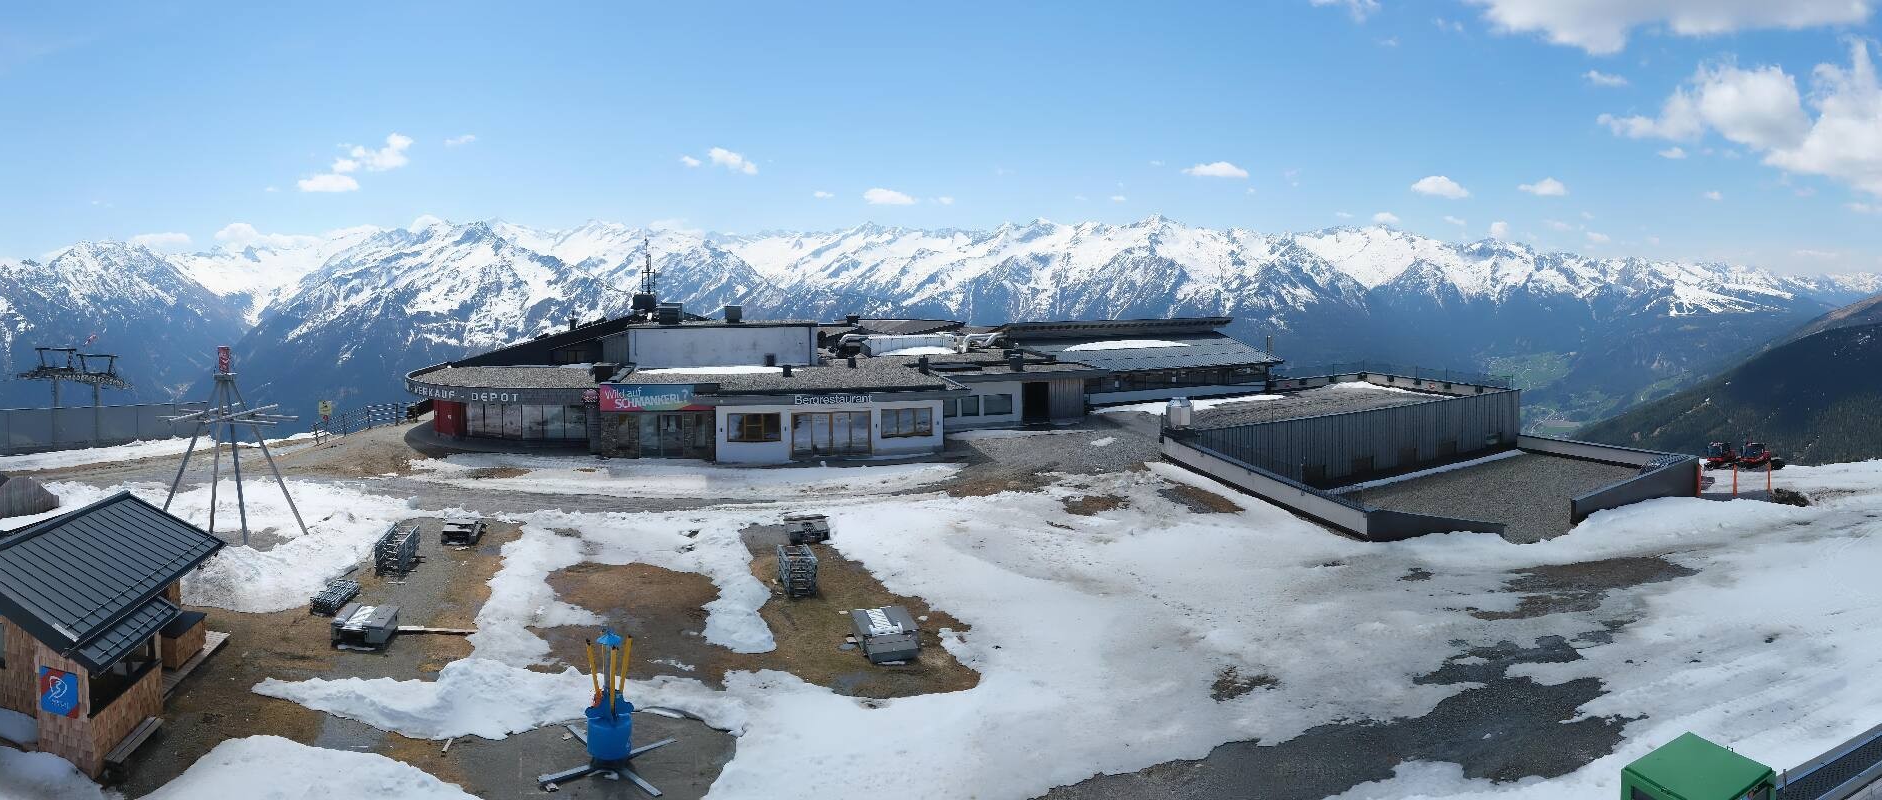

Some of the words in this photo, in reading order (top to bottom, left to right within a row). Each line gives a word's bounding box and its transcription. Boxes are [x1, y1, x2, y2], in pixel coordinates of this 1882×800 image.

[414, 385, 455, 399] VERKAUF
[472, 392, 519, 402] DEPOT
[605, 389, 625, 400] Wild
[627, 386, 642, 398] auf
[615, 389, 688, 409] SCHMANKERL?
[795, 394, 872, 405] Bergrestaurant
